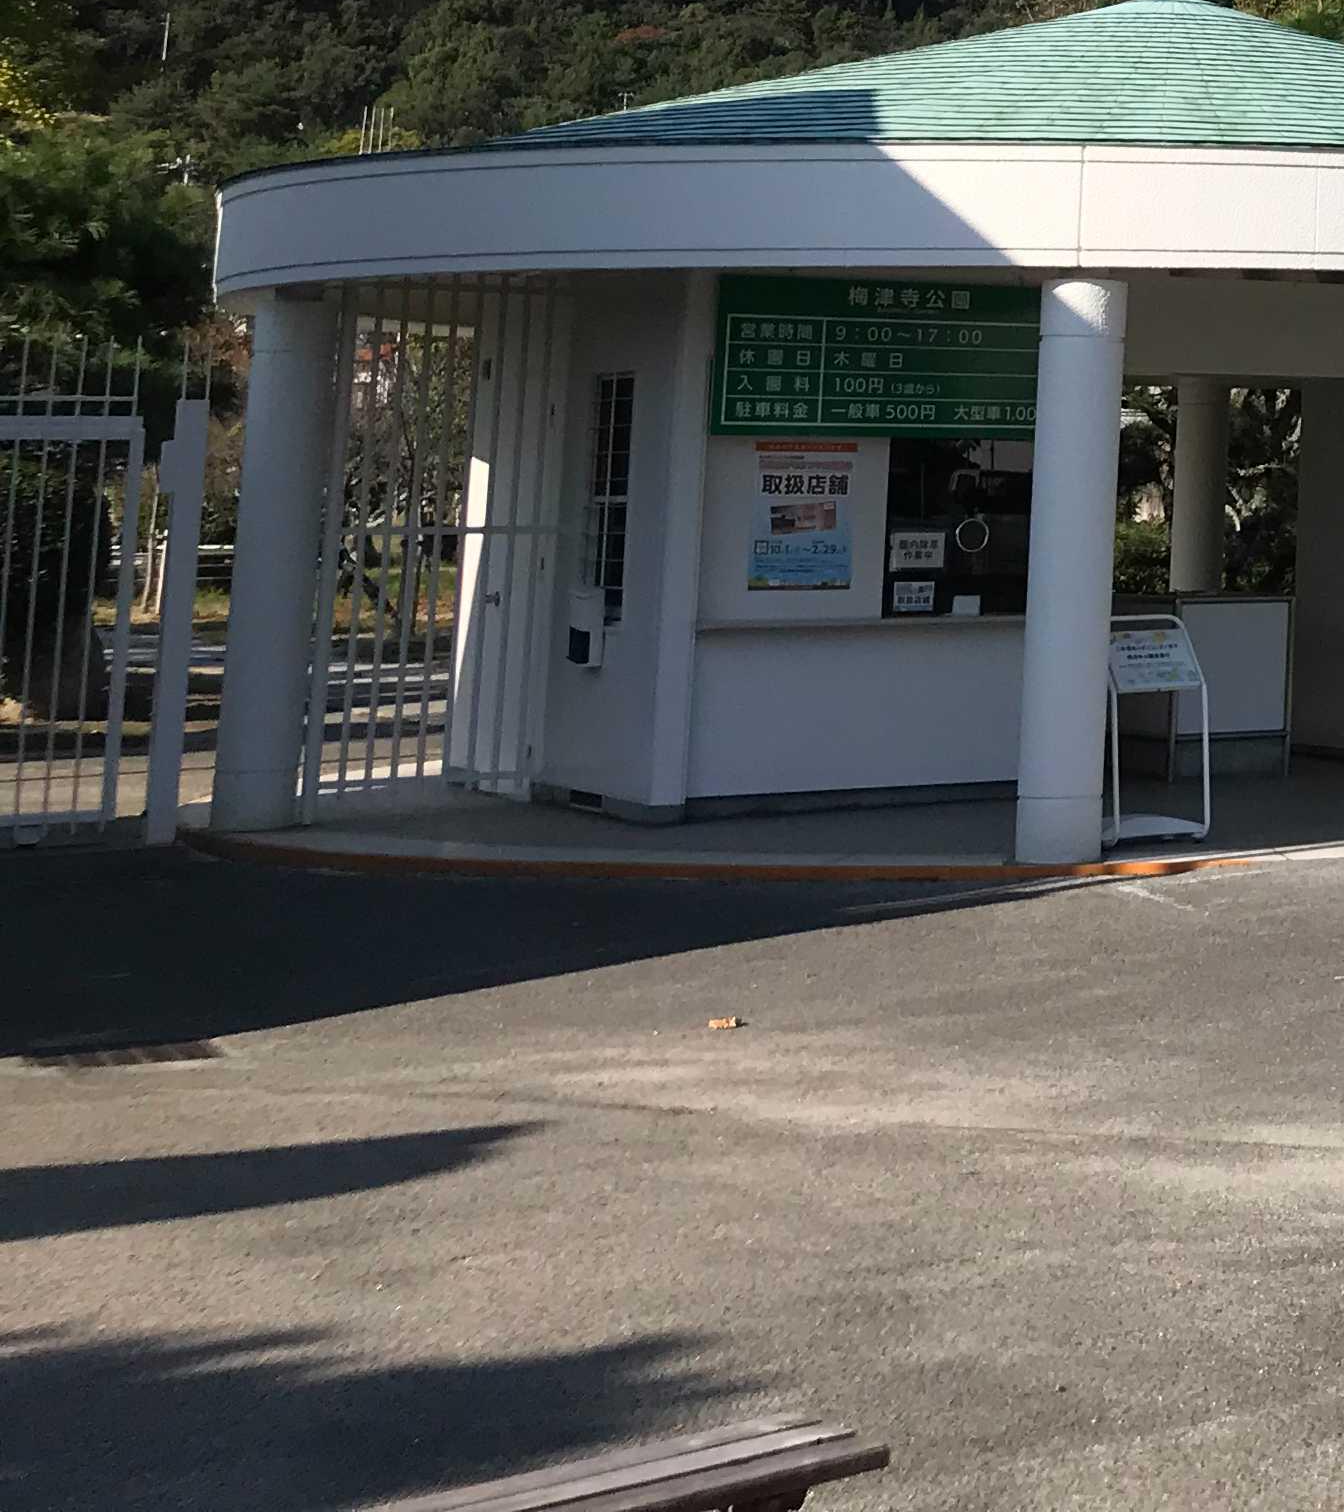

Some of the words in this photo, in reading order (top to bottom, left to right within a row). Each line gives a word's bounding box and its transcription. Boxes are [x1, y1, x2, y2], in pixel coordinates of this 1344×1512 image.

[847, 286, 970, 310] 梅津寺公園
[740, 322, 813, 340] 営業時間
[739, 348, 811, 366] 休園日
[833, 351, 904, 368] 木曜日
[737, 375, 810, 392] 入園料
[833, 377, 884, 394] 100円
[735, 401, 809, 419] 駐車料金
[761, 474, 849, 496] 取扱店舗
